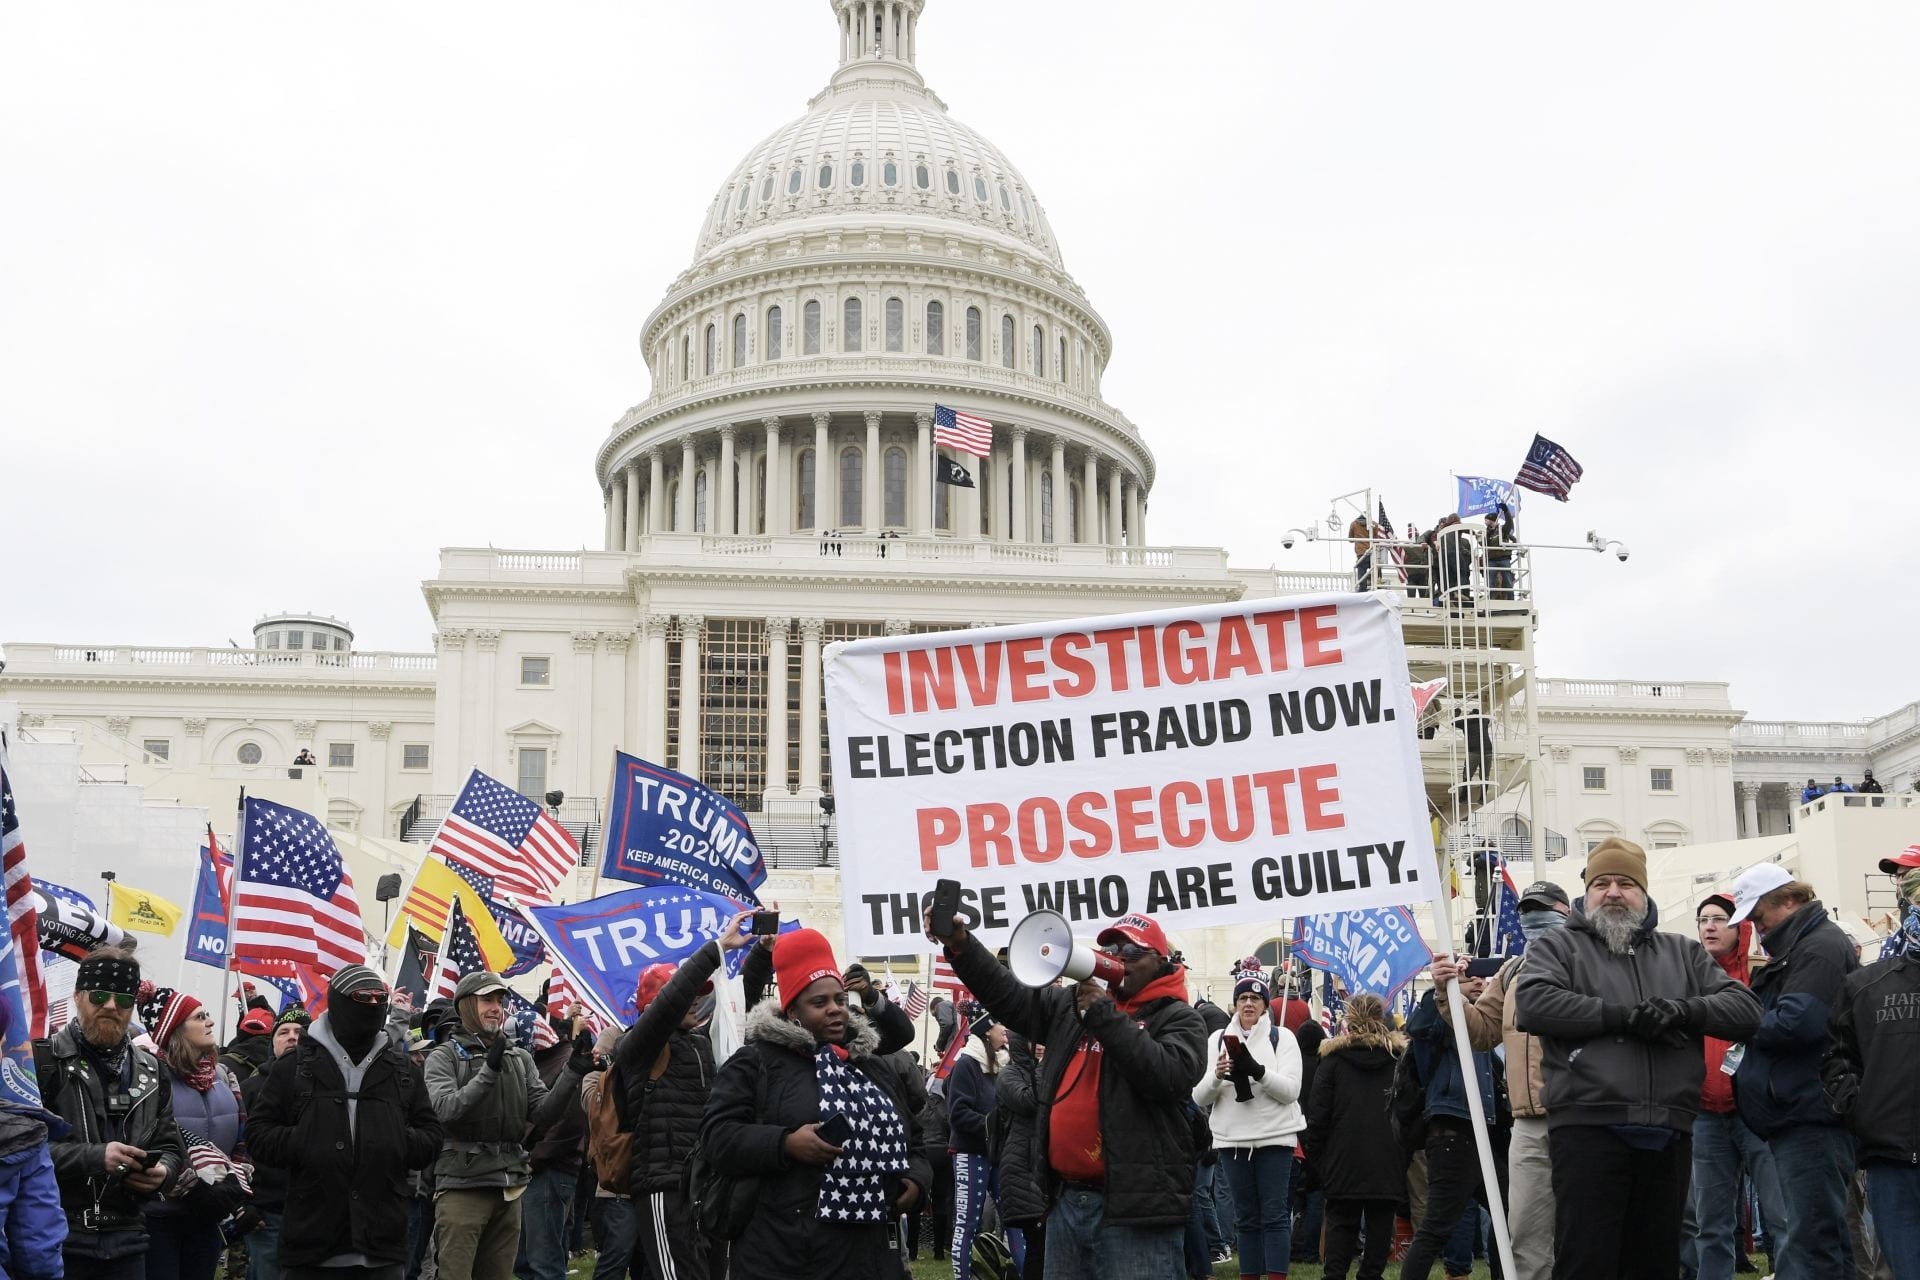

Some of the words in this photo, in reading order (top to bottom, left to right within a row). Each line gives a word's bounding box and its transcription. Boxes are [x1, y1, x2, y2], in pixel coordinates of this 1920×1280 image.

[882, 604, 1343, 715] INVESTIGATE
[848, 718, 1074, 778] ELECTION
[1091, 698, 1251, 757] FRAUD
[1269, 678, 1395, 736] NOW.
[635, 775, 759, 867] TRUMP
[916, 763, 1346, 871] PROSECUTE
[626, 848, 654, 864] KEEP
[654, 855, 709, 885] AMERICA
[1021, 875, 1128, 921] WHO
[1146, 862, 1237, 913] ARE
[1251, 840, 1418, 901] GUILTY.
[41, 917, 77, 938] VOTING
[197, 934, 225, 953] NO
[572, 907, 749, 971] TRUM
[1375, 907, 1412, 943] YOU
[1309, 911, 1390, 987] RUMP
[1313, 936, 1349, 965] BLES
[956, 1153, 969, 1181] MAKE
[955, 1182, 969, 1225] AMERICA
[951, 1226, 966, 1258] GREAT
